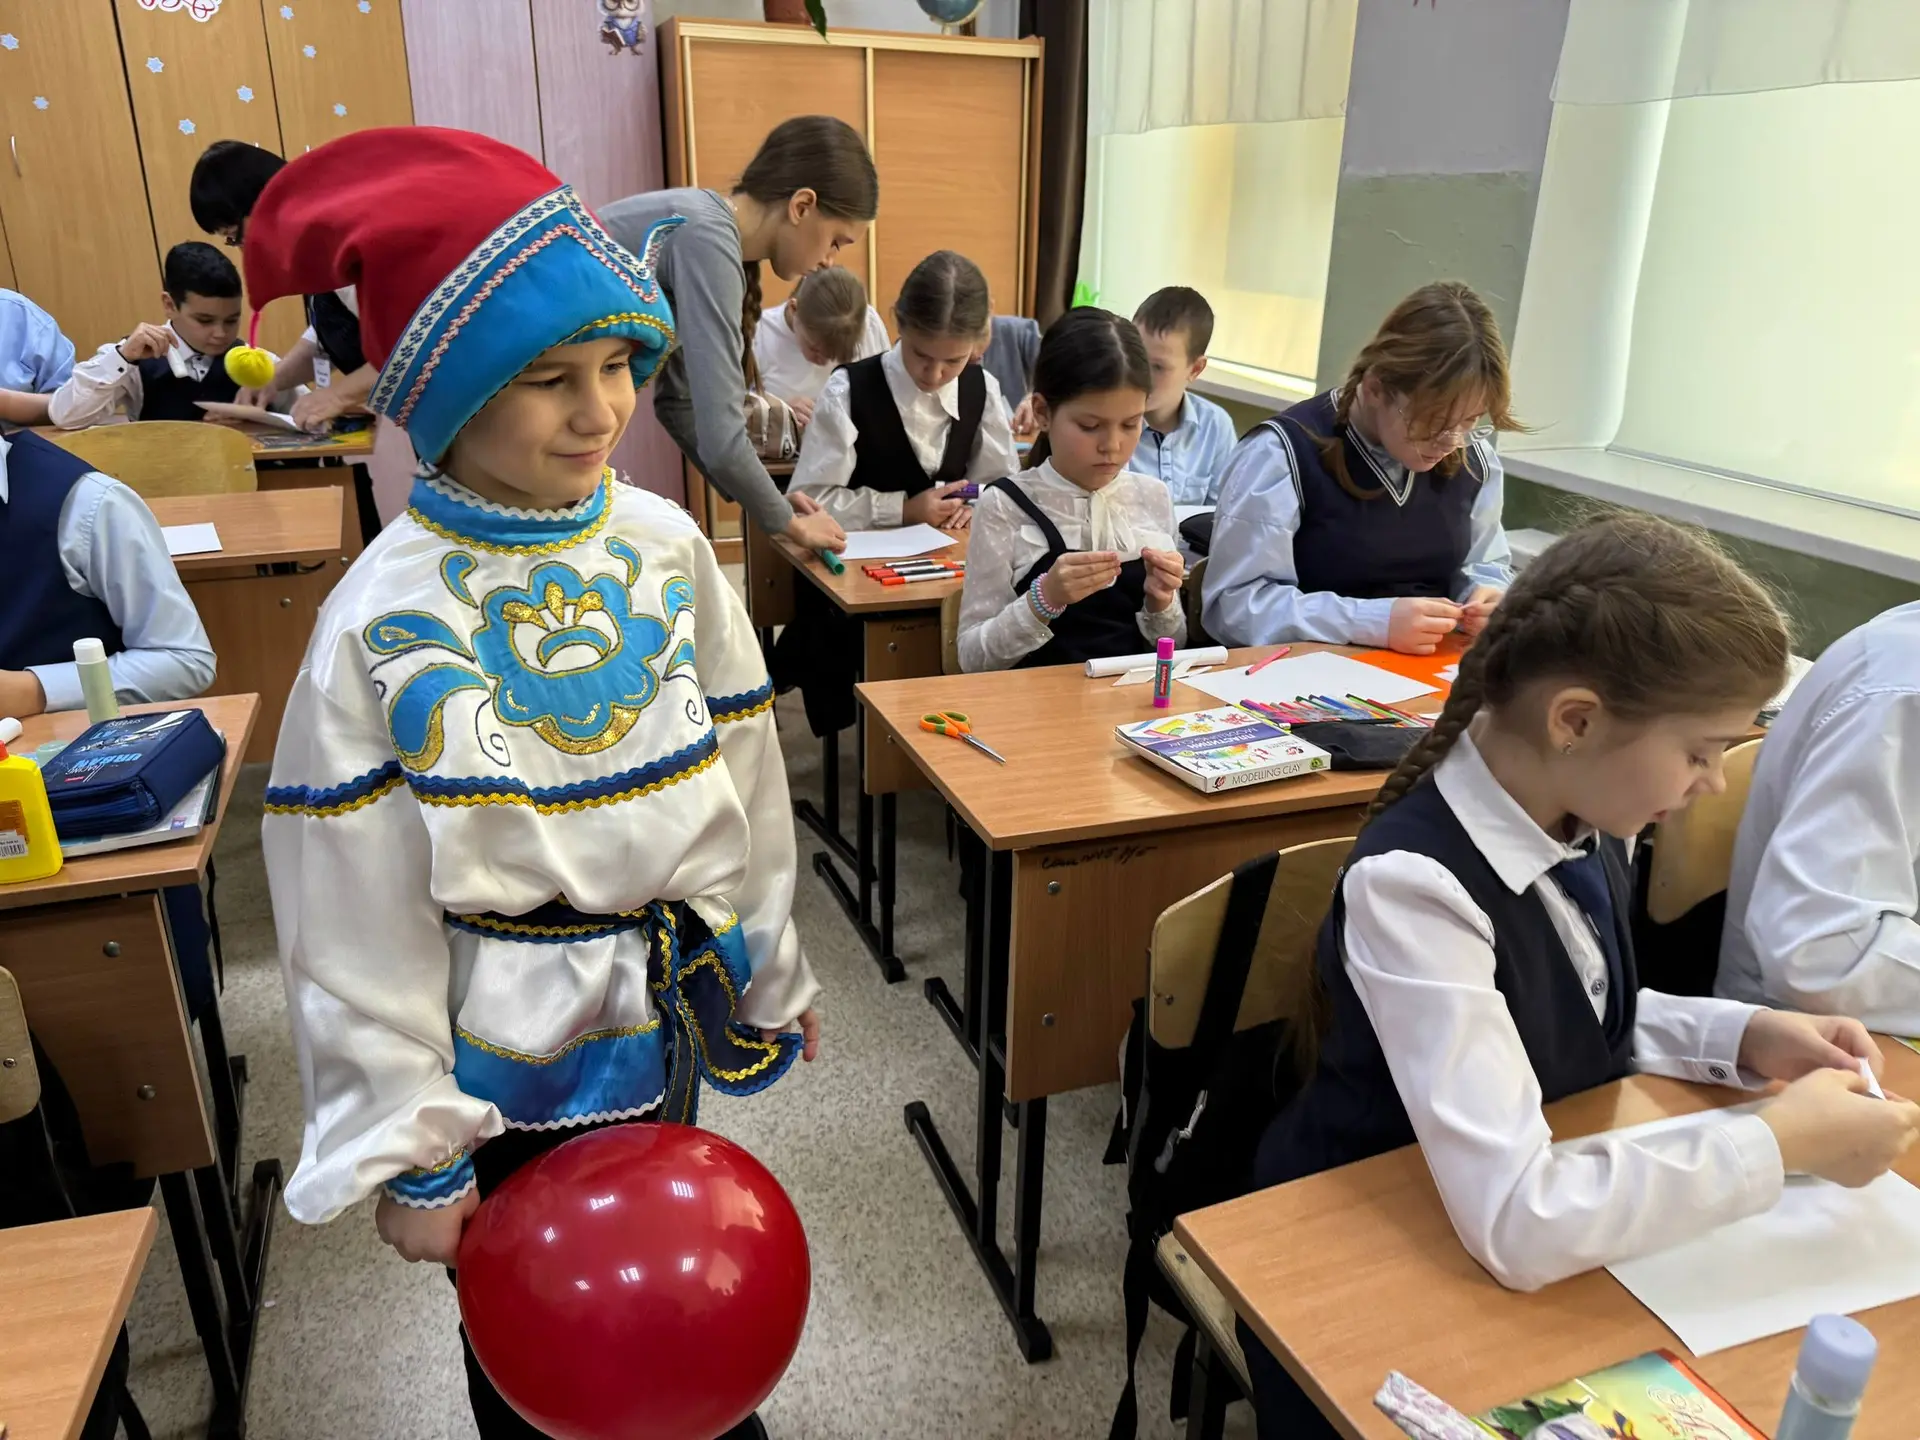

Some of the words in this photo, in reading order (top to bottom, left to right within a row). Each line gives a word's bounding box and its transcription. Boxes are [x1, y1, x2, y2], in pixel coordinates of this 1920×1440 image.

[1186, 733, 1256, 749] ПЛАСТИЛИН
[1231, 766, 1281, 785] MODELLING
[1282, 763, 1302, 776] CLAY
